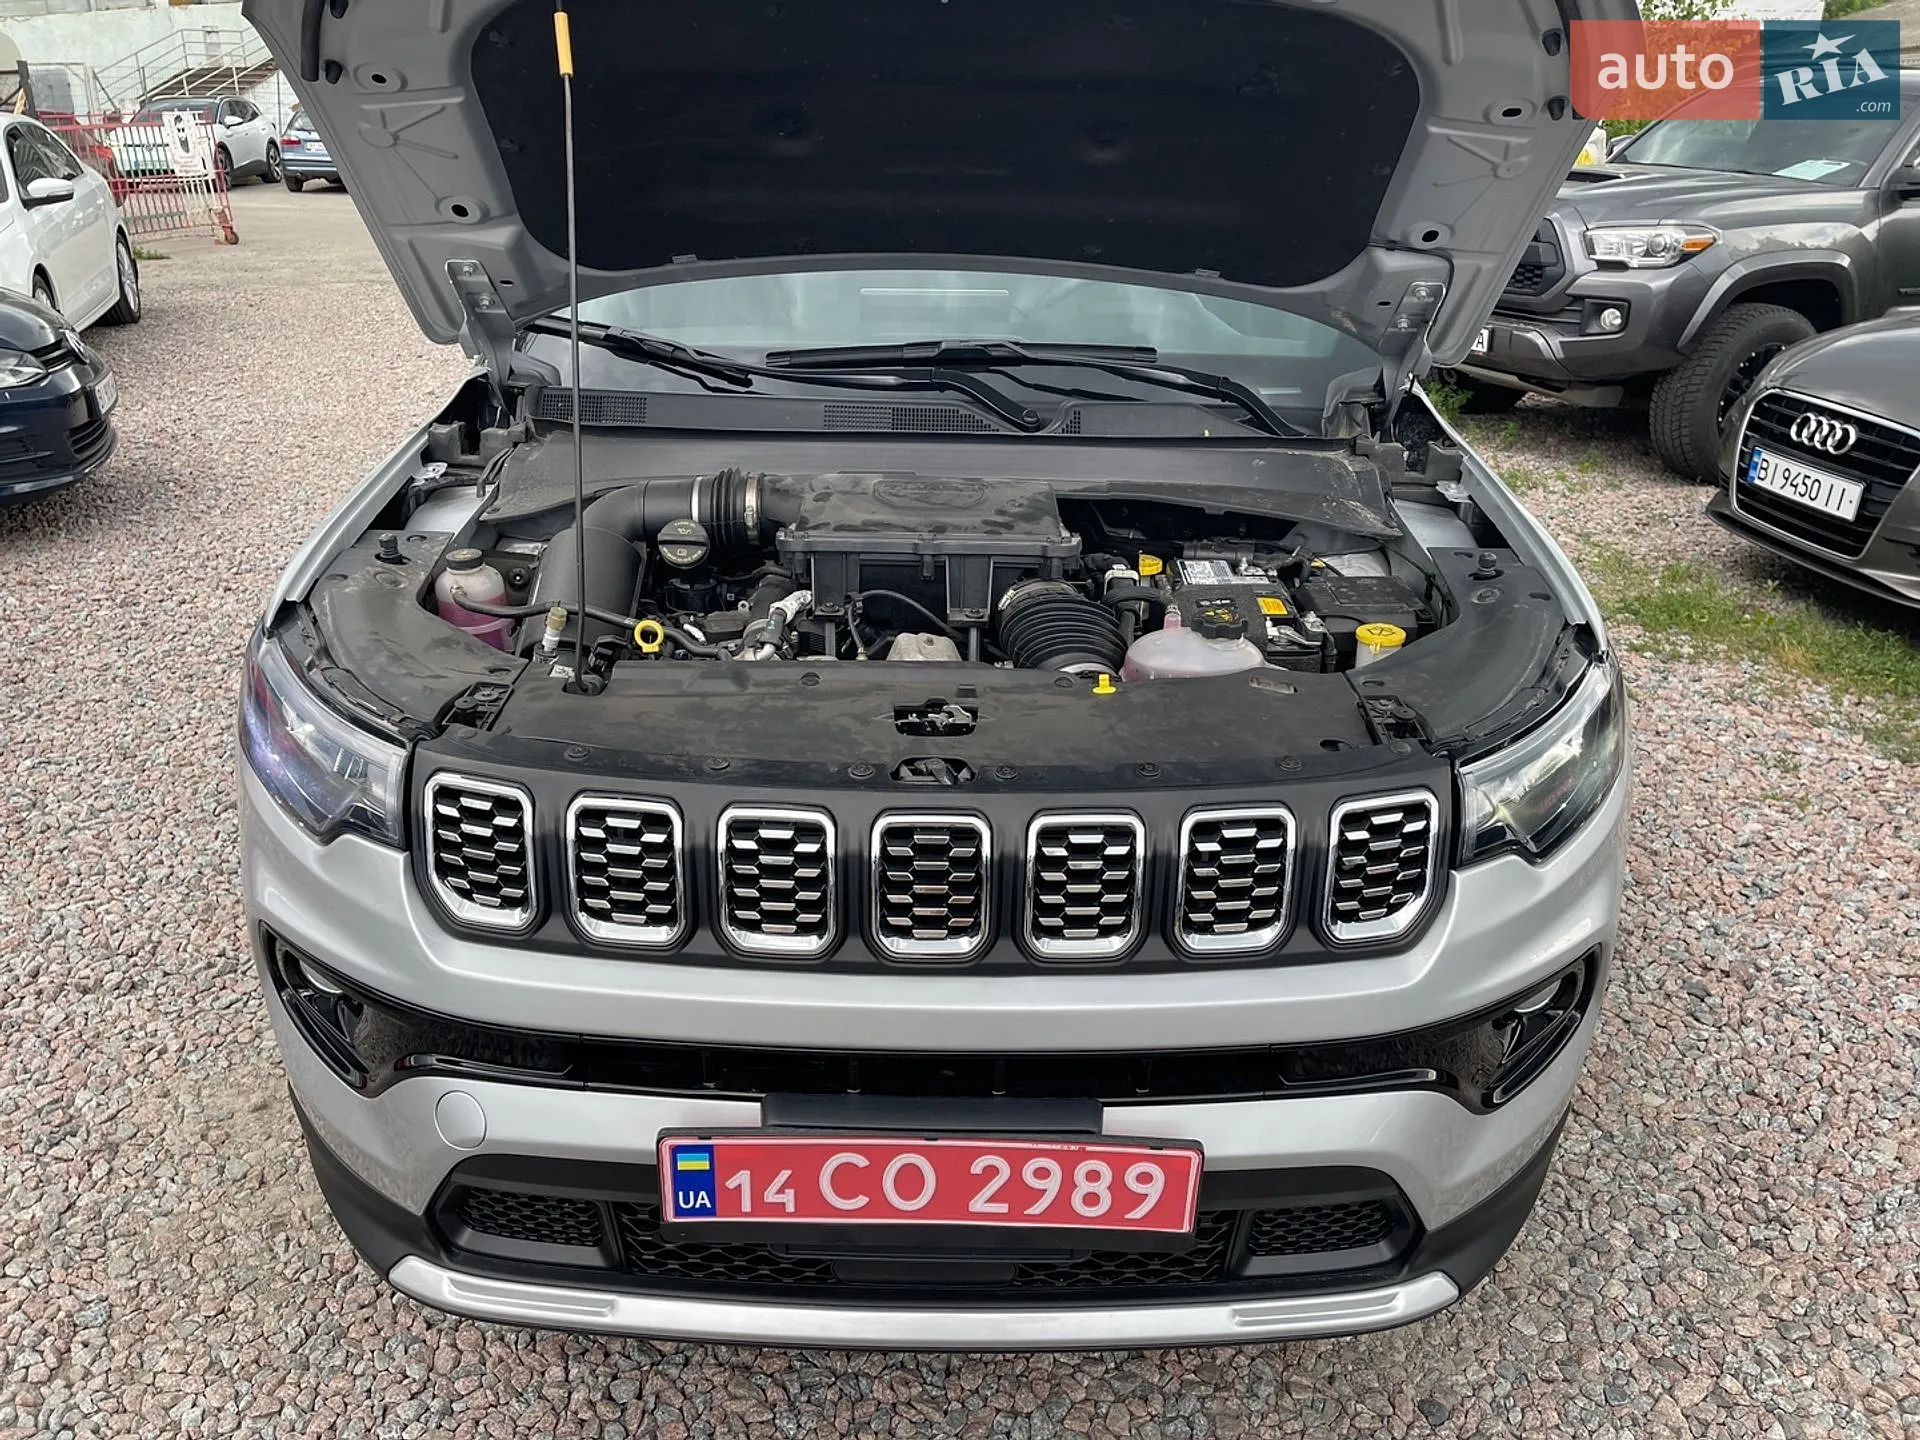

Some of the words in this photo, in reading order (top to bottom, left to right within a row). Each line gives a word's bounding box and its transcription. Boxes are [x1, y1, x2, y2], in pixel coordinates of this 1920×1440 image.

[1757, 458, 1778, 485] BI
[1780, 468, 1821, 501] 9450
[678, 1190, 712, 1210] UA
[725, 1169, 796, 1213] 14
[818, 1151, 937, 1212] CO
[968, 1154, 1166, 1220] 2989
